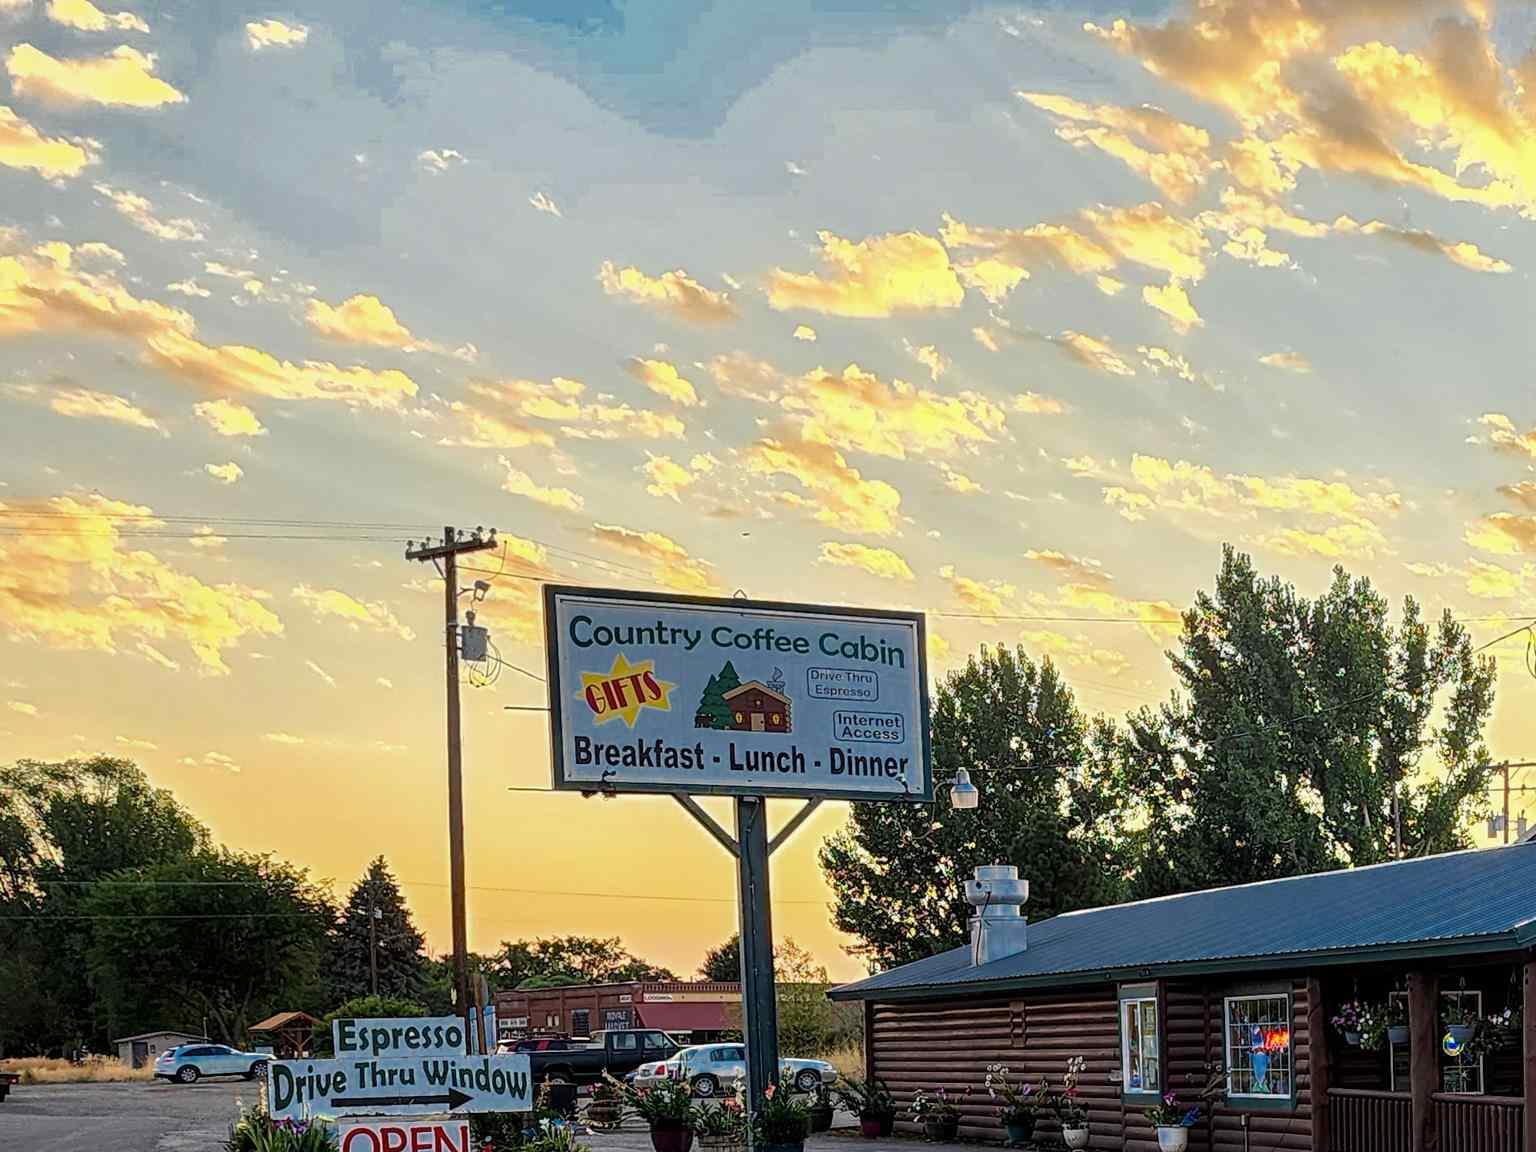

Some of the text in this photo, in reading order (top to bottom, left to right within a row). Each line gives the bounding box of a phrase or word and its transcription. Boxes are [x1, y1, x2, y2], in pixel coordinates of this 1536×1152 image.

[569, 615, 905, 668] Country Coffee Cabin
[585, 670, 662, 714] GIFTS
[810, 670, 873, 684] Drive Thru
[815, 684, 871, 697] Espresso
[838, 713, 901, 728] Internet
[841, 727, 899, 741] Access
[574, 735, 704, 769] Breakfast
[729, 742, 805, 774] Lunch
[829, 747, 908, 778] Dinner
[338, 1020, 462, 1056] Espresso
[272, 1058, 528, 1111] Drive Thru Window
